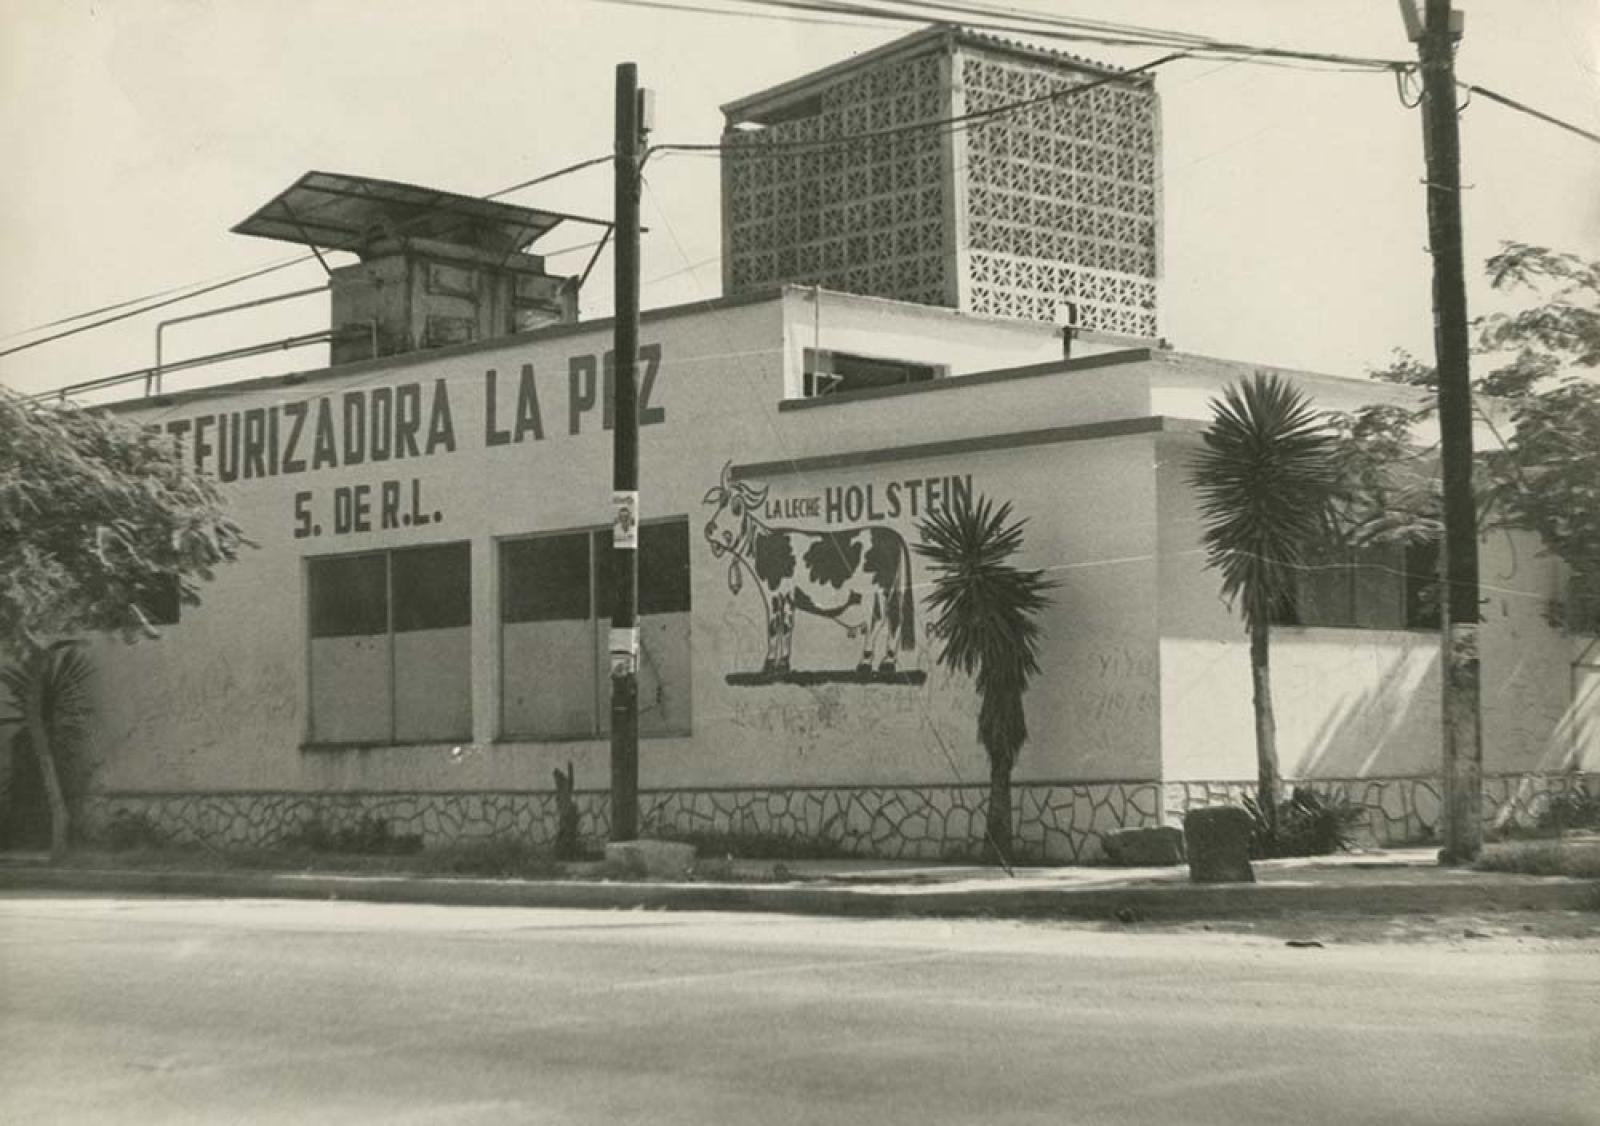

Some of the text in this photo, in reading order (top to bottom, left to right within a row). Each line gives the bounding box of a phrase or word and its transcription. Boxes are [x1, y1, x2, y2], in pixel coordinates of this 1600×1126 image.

[143, 378, 456, 484] TEURIZADORA
[486, 363, 544, 446] LA
[294, 478, 443, 539] S. DE R.L.
[765, 474, 972, 523] LA LECHE HOLSTEIN
